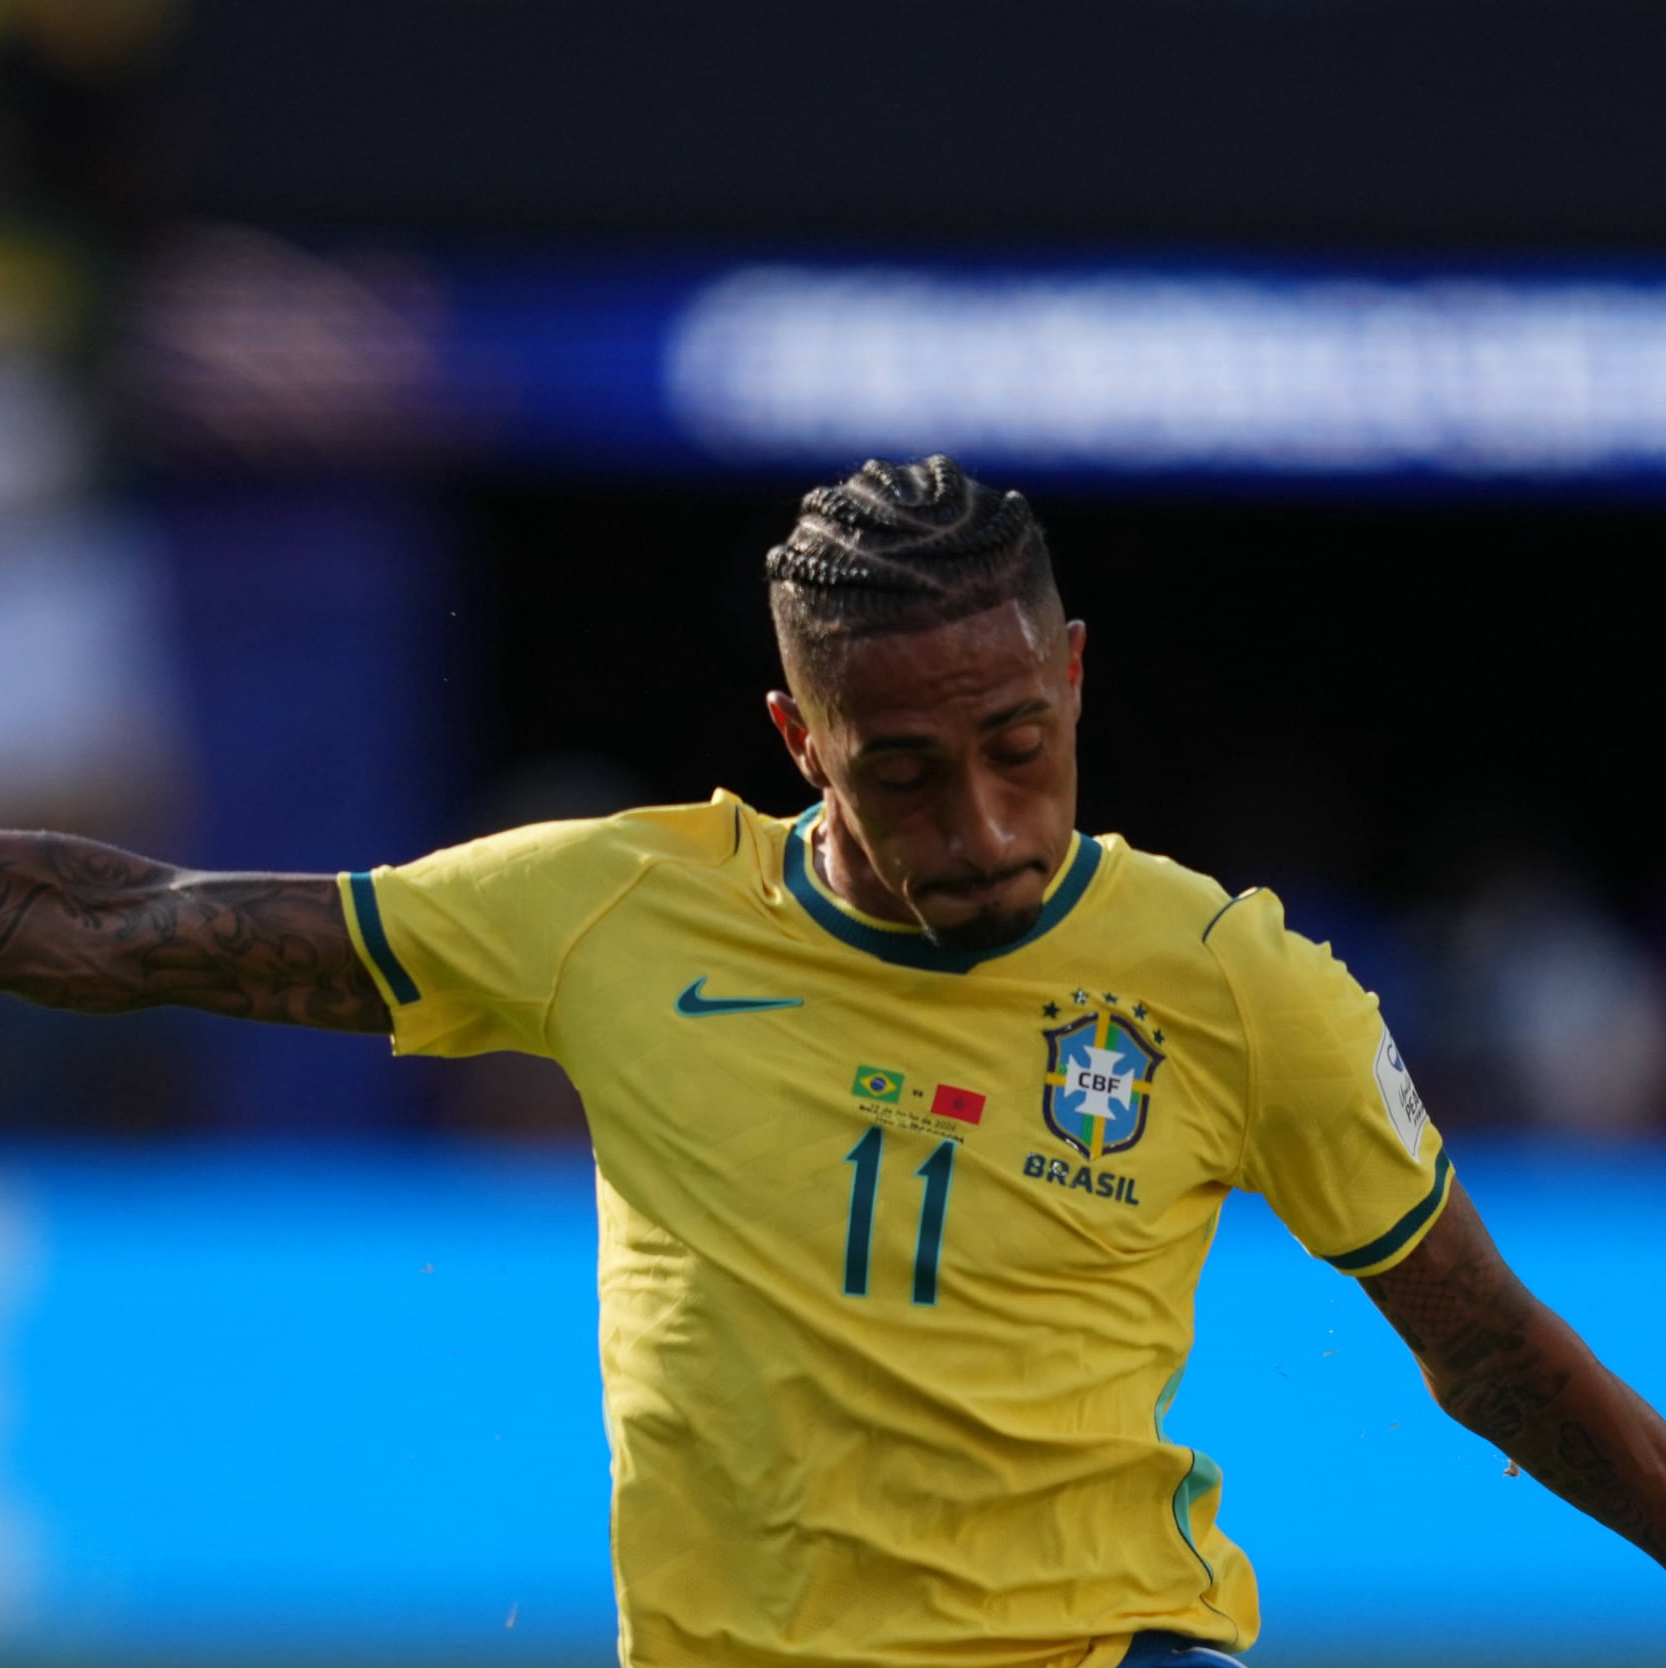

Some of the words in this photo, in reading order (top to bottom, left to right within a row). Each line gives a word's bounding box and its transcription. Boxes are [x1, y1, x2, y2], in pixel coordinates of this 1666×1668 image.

[1077, 1071, 1121, 1094] CBF
[1022, 1151, 1140, 1206] BRASIL
[843, 1126, 960, 1306] 11
